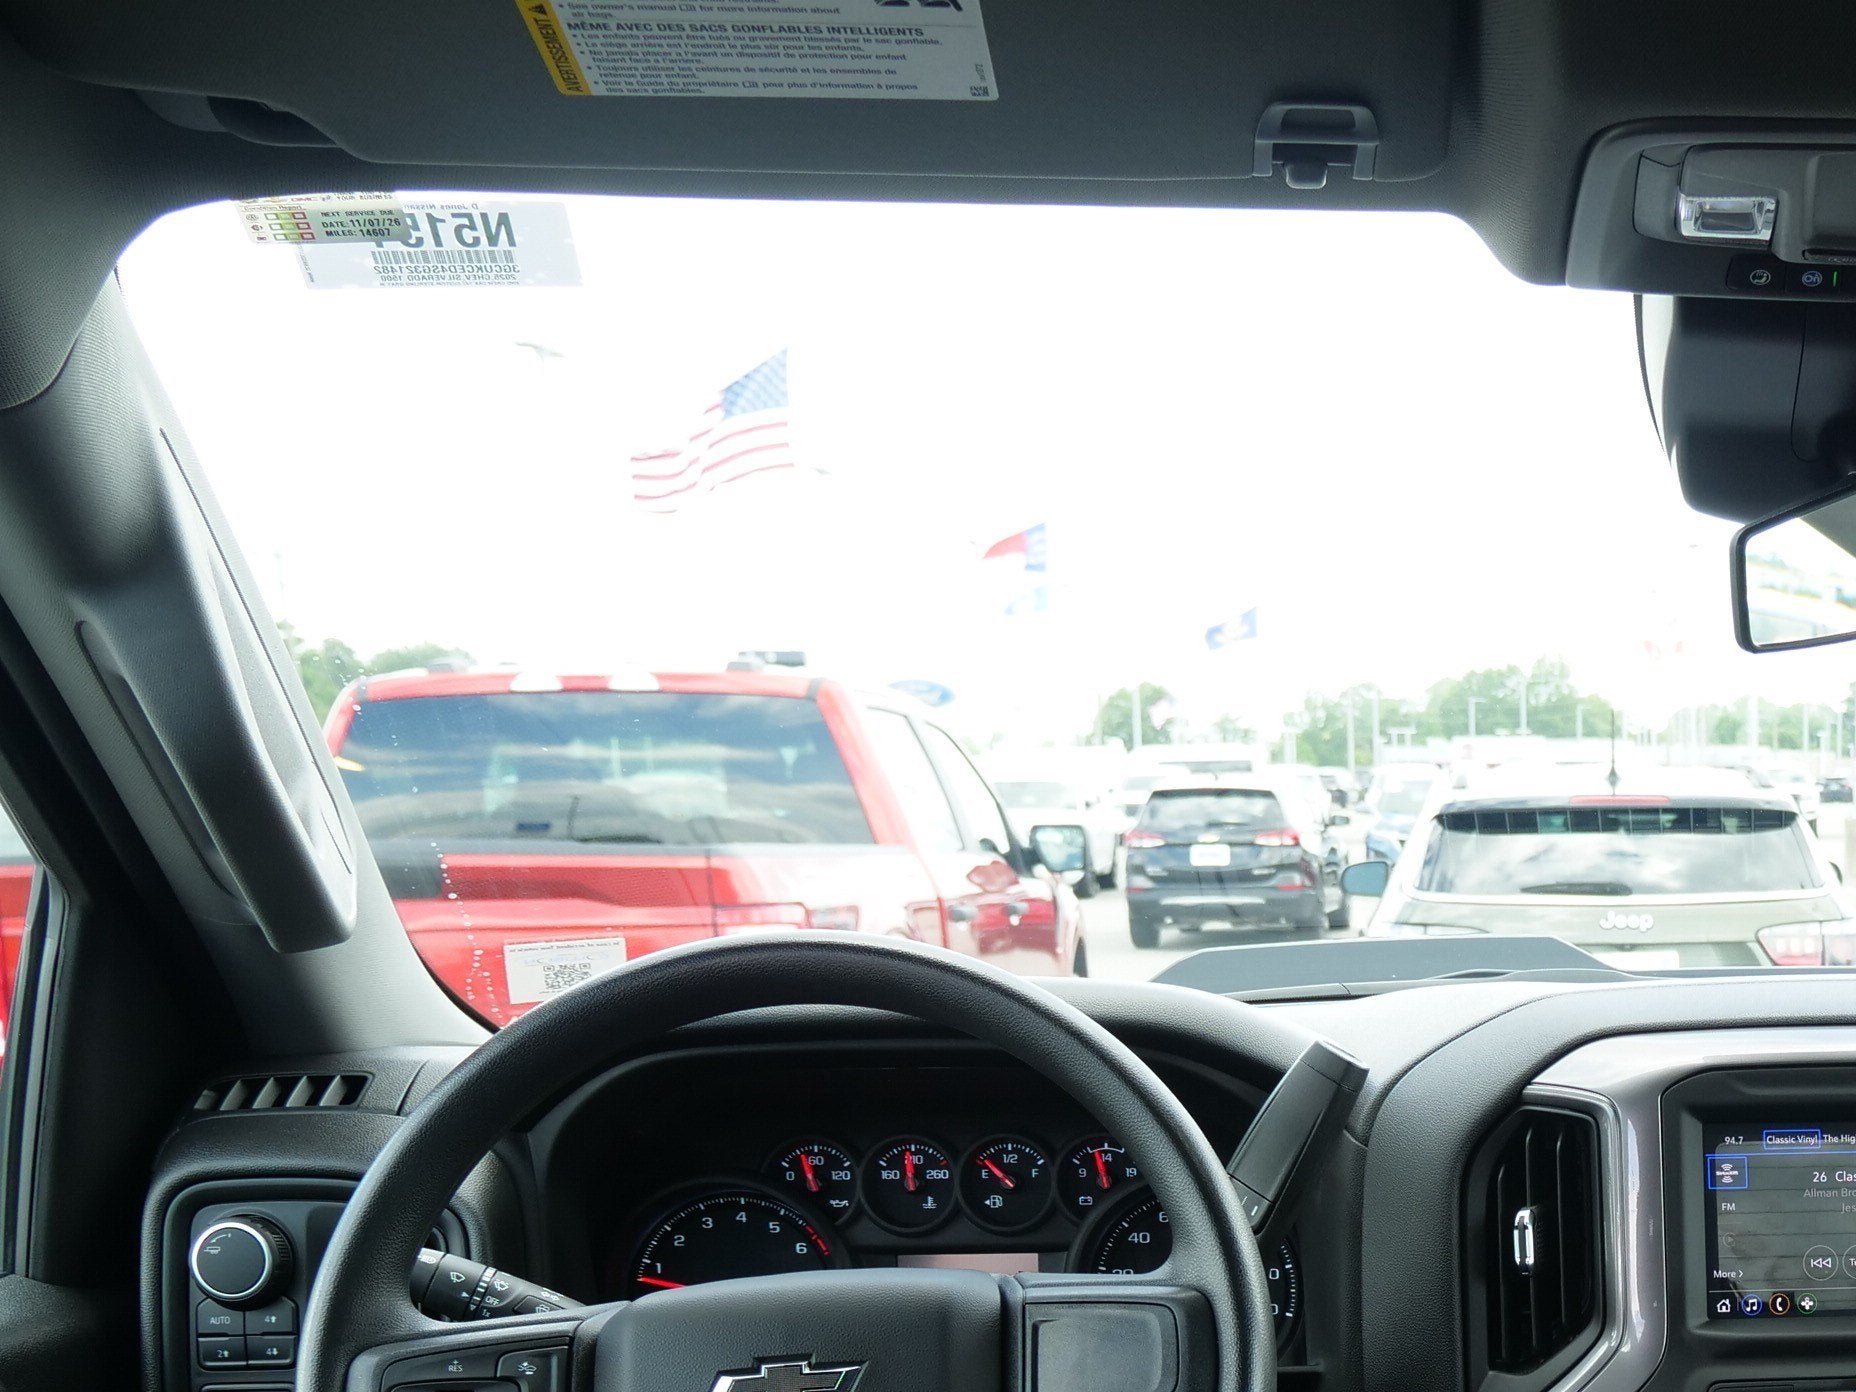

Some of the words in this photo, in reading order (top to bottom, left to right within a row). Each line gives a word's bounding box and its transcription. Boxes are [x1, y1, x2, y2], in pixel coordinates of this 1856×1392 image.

[616, 23, 652, 31] AVEC
[656, 24, 686, 32] DES
[689, 24, 728, 32] SACS
[732, 24, 824, 34] GONFLABLES
[826, 26, 924, 36] INTELLIGENTS
[350, 218, 401, 228] 11/07/26
[326, 230, 358, 238] MILES:
[360, 228, 391, 238] 14607
[1600, 911, 1653, 932] Jeep
[1724, 1136, 1743, 1145] 94.7
[1766, 1135, 1796, 1144] Classic
[1797, 1134, 1819, 1146] Vinyl
[1823, 1134, 1839, 1142] The
[808, 1156, 824, 1166] 60
[1003, 1154, 1018, 1164] 1/2
[1102, 1153, 1113, 1162] 14
[786, 1171, 794, 1180] 0
[831, 1171, 851, 1180] 120
[881, 1170, 900, 1180] 160
[926, 1170, 949, 1180] 260
[982, 1169, 989, 1178] E
[1032, 1168, 1040, 1178] F
[1079, 1168, 1087, 1178] 9
[1126, 1168, 1138, 1177] 19
[1812, 1172, 1828, 1182] 26
[1803, 1188, 1838, 1198] Allman
[1722, 1203, 1736, 1211] FM
[736, 1212, 747, 1223] 4
[702, 1217, 714, 1229] 3
[768, 1222, 781, 1234] 5
[674, 1235, 685, 1247] 2
[1128, 1232, 1150, 1244] 40
[796, 1242, 808, 1254] 6
[656, 1262, 662, 1274] 1
[1713, 1270, 1736, 1279] More
[484, 1295, 500, 1306] OFF
[210, 1316, 230, 1324] AUTO
[448, 1364, 464, 1372] RES
